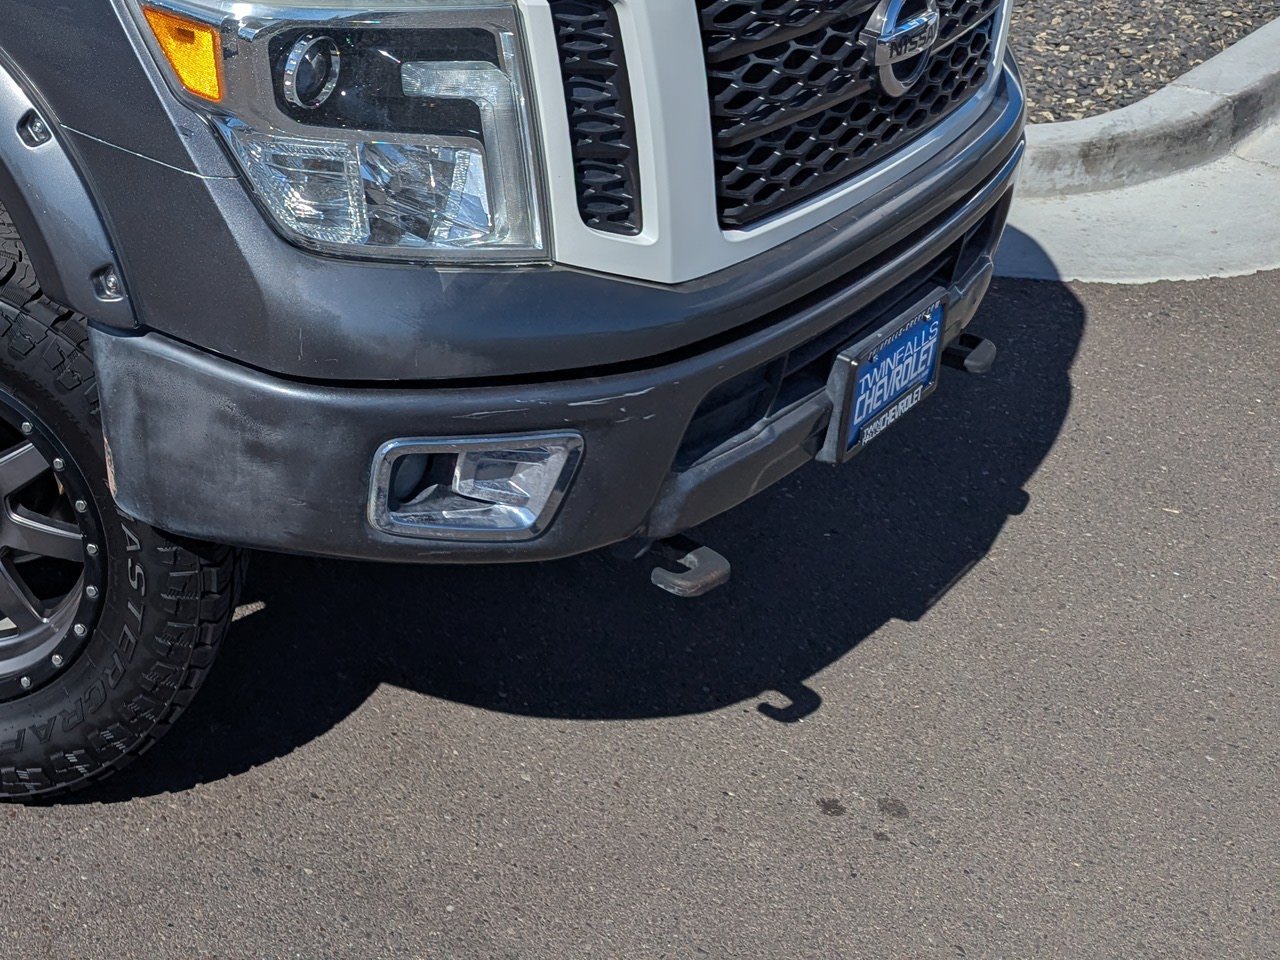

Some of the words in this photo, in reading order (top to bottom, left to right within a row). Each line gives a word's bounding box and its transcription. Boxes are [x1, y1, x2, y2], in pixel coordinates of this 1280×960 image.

[853, 338, 937, 425] CHEVROLET
[859, 320, 939, 394] TWINFALLS
[881, 385, 924, 432] CHEVROLET
